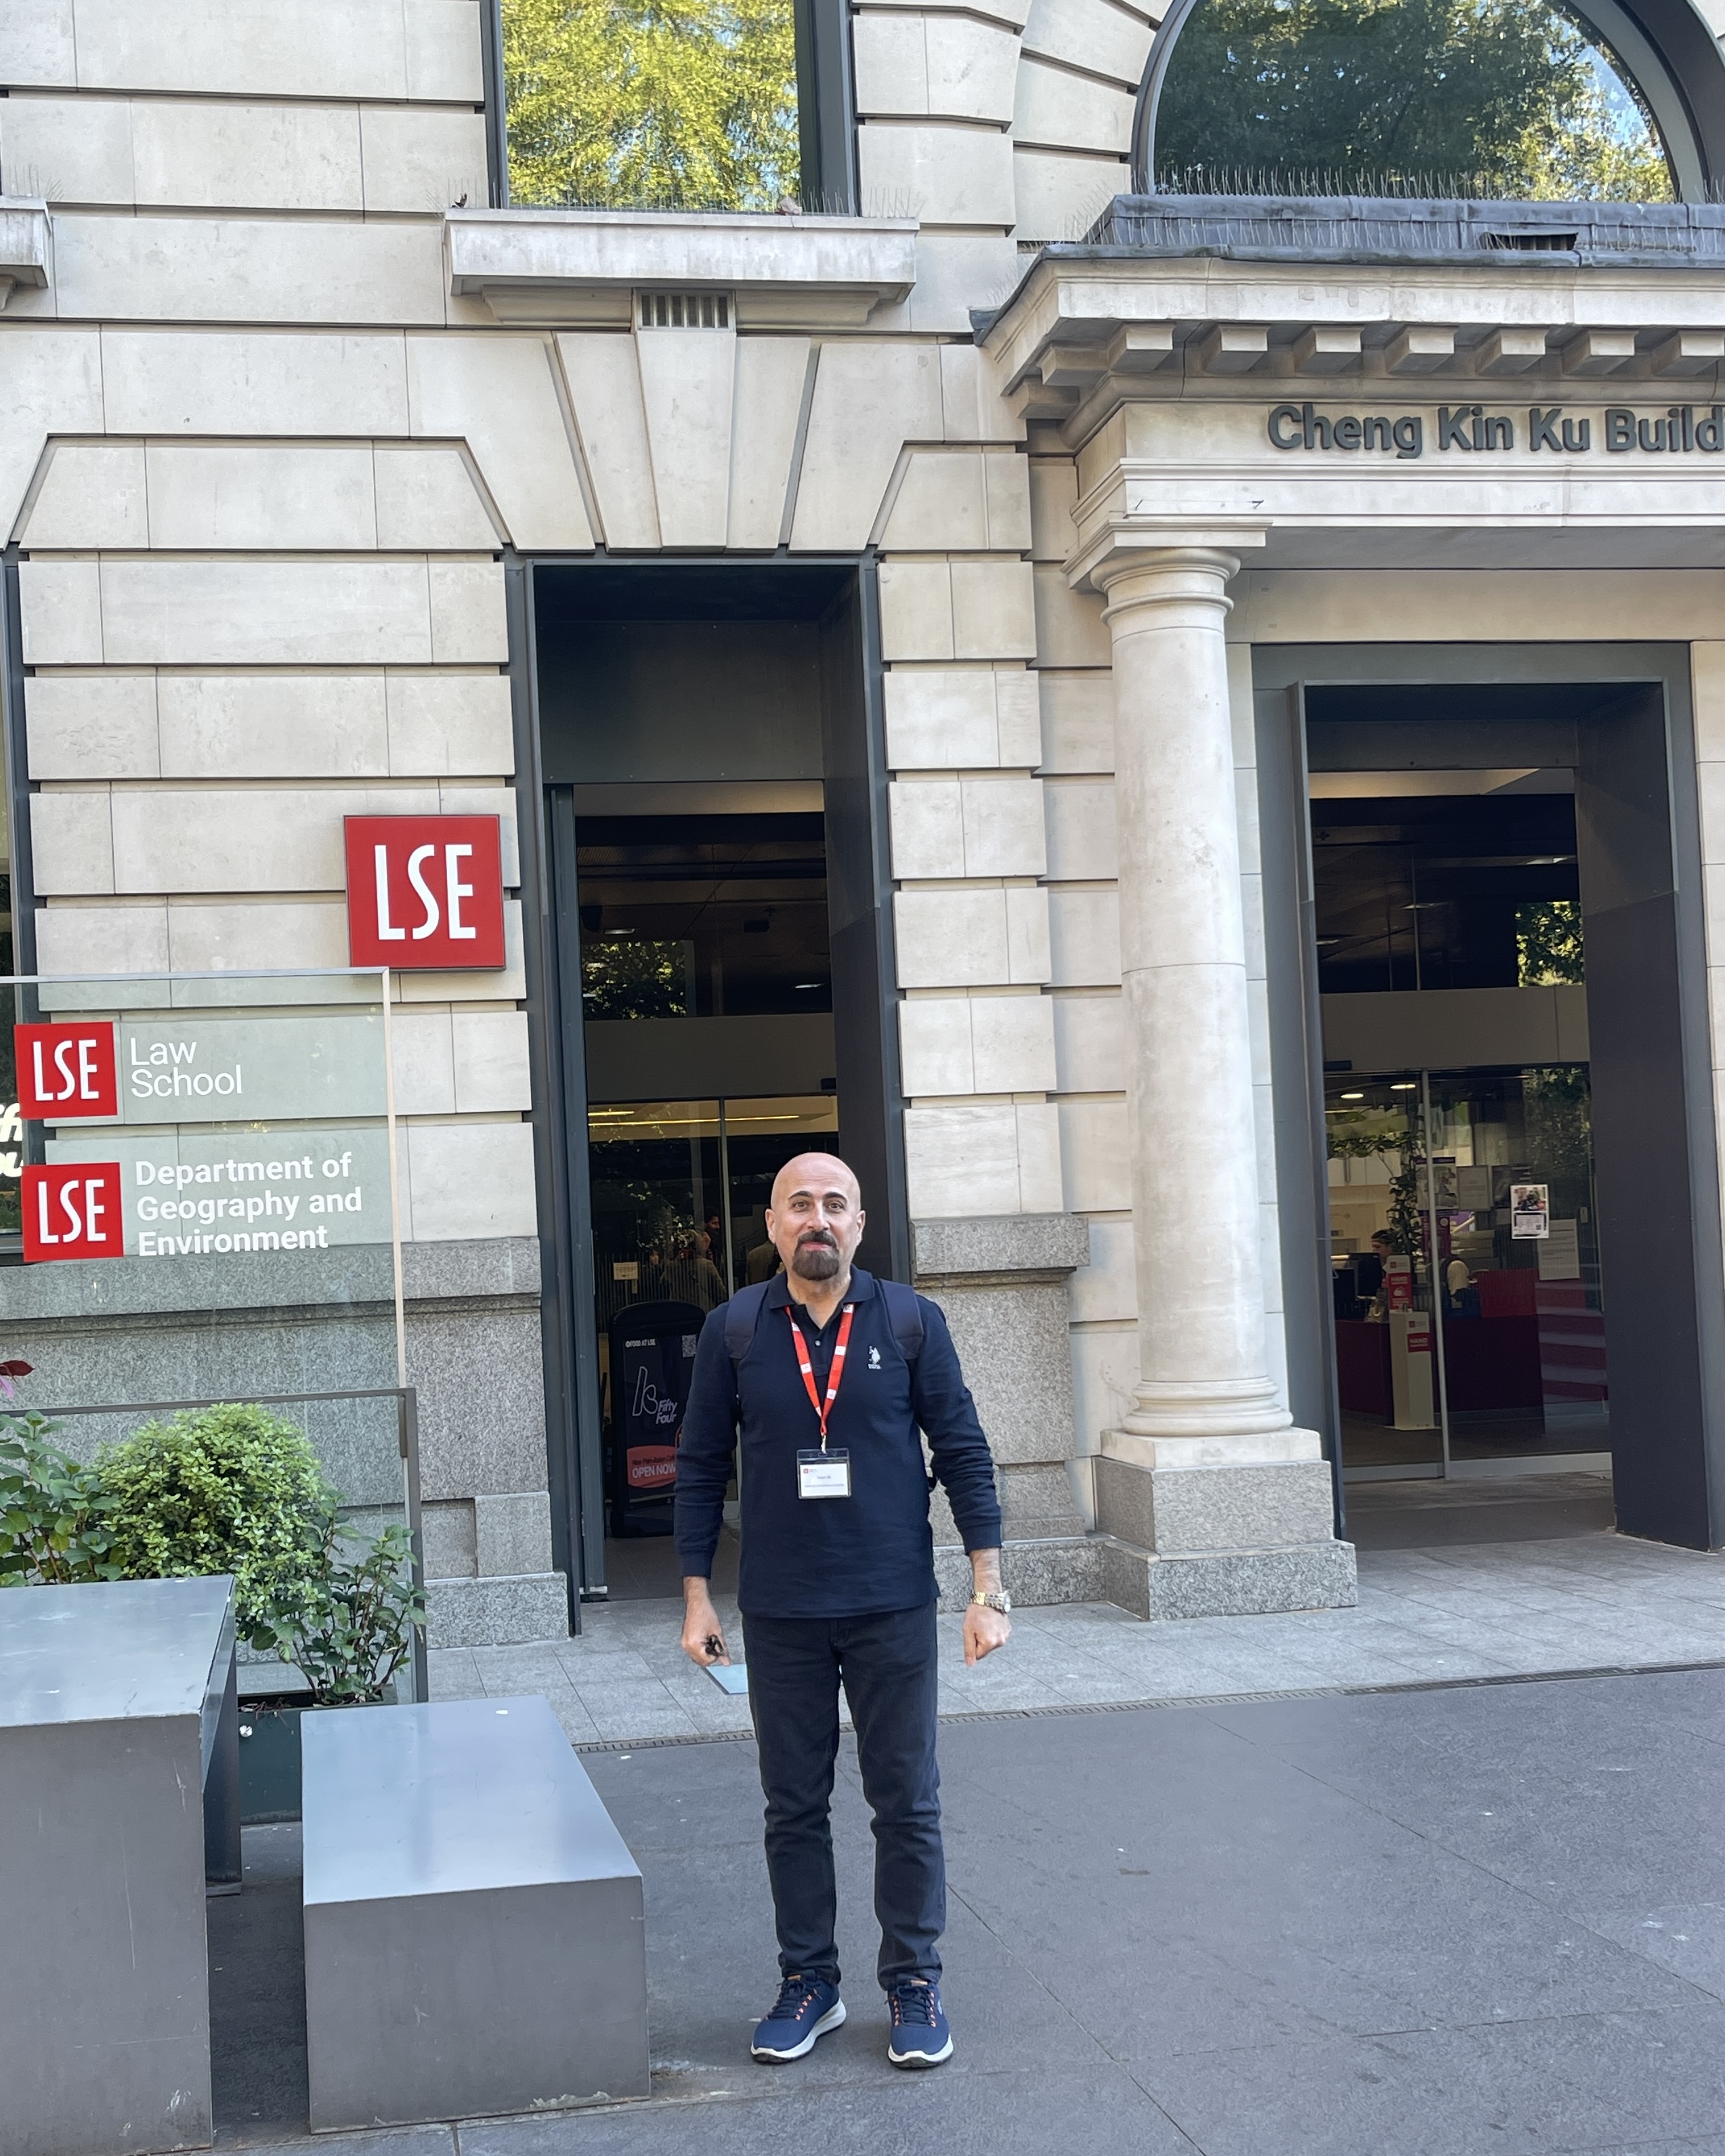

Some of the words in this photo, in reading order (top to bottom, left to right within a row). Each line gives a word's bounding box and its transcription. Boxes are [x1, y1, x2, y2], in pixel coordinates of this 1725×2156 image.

[1267, 402, 1423, 460] Cheng
[1438, 406, 1514, 451] Kin
[1529, 407, 1590, 452] Ku
[1604, 406, 1725, 452] Build
[375, 844, 476, 941] LSE
[131, 1037, 197, 1066] Law
[33, 1039, 100, 1101] LSE
[131, 1064, 242, 1098] School
[135, 1156, 314, 1190] Department
[322, 1152, 352, 1178] of
[38, 1179, 106, 1244] LSE
[137, 1191, 300, 1224] Geography
[309, 1186, 362, 1213] and
[139, 1225, 328, 1257] Environment
[656, 1413, 677, 1424] Four
[658, 1399, 677, 1414] Fifty
[632, 1465, 655, 1478] OPEN
[656, 1463, 676, 1475] NOW
